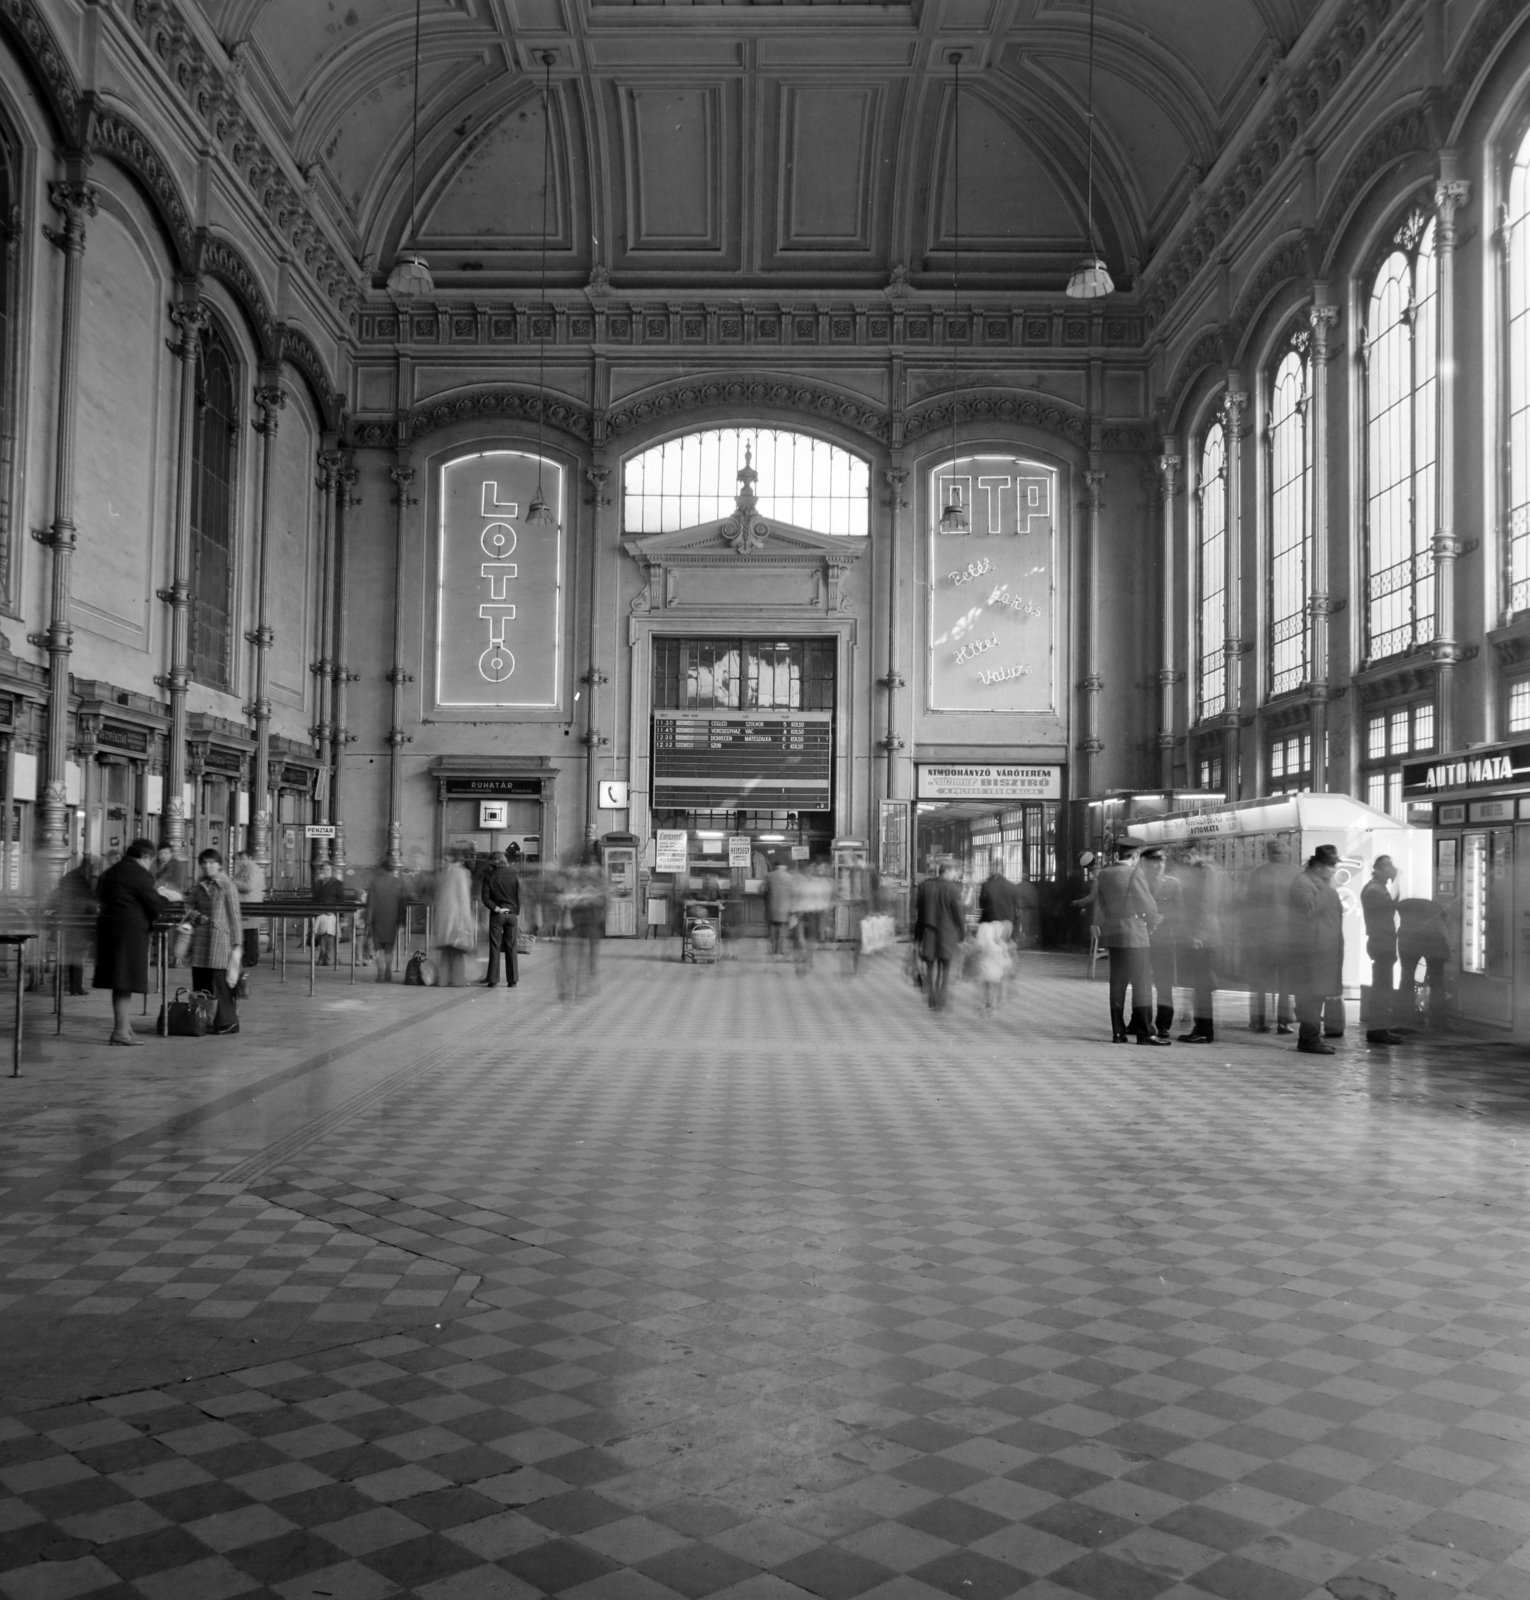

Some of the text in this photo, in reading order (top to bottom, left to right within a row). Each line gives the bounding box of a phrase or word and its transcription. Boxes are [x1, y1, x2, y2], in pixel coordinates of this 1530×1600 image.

[939, 475, 1050, 534] OTP
[478, 481, 518, 683] LOTTO
[952, 631, 1002, 664] Hitel
[978, 662, 1034, 685] Valuta
[471, 781, 513, 789] RUHATÁR
[980, 778, 1050, 787] BISZTRÓ
[996, 768, 1051, 777] VÁRÓTEREM
[1425, 755, 1513, 788] AUTOMATA
